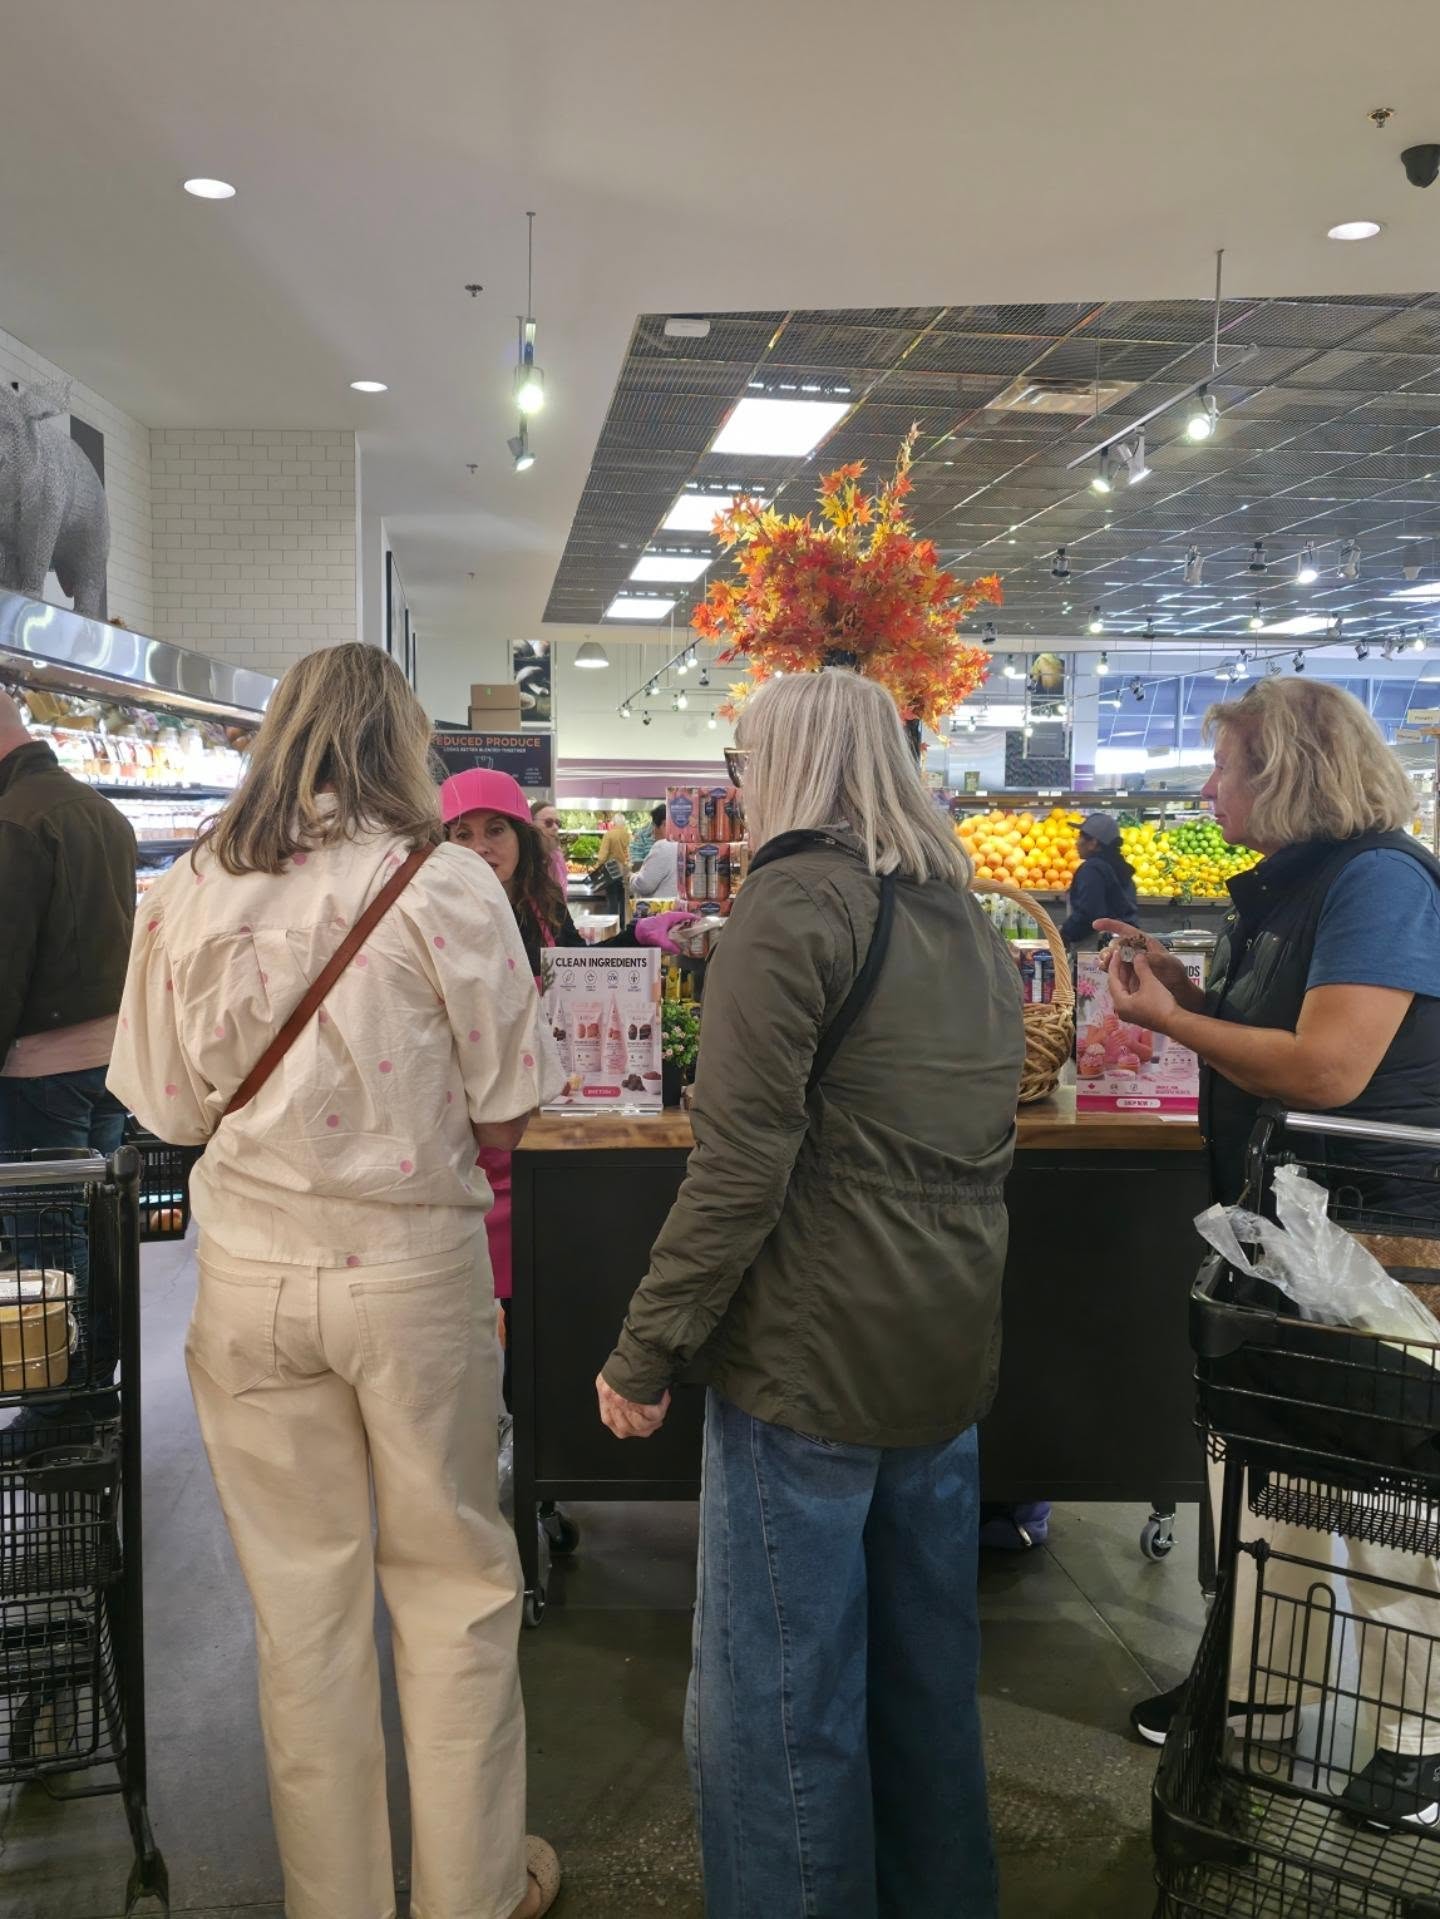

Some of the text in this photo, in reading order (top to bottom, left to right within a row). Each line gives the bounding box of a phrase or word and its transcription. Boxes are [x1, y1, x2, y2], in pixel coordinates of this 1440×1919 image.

[486, 736, 541, 747] PRODUCE
[555, 957, 647, 968] CLEAN INGREDIENTS
